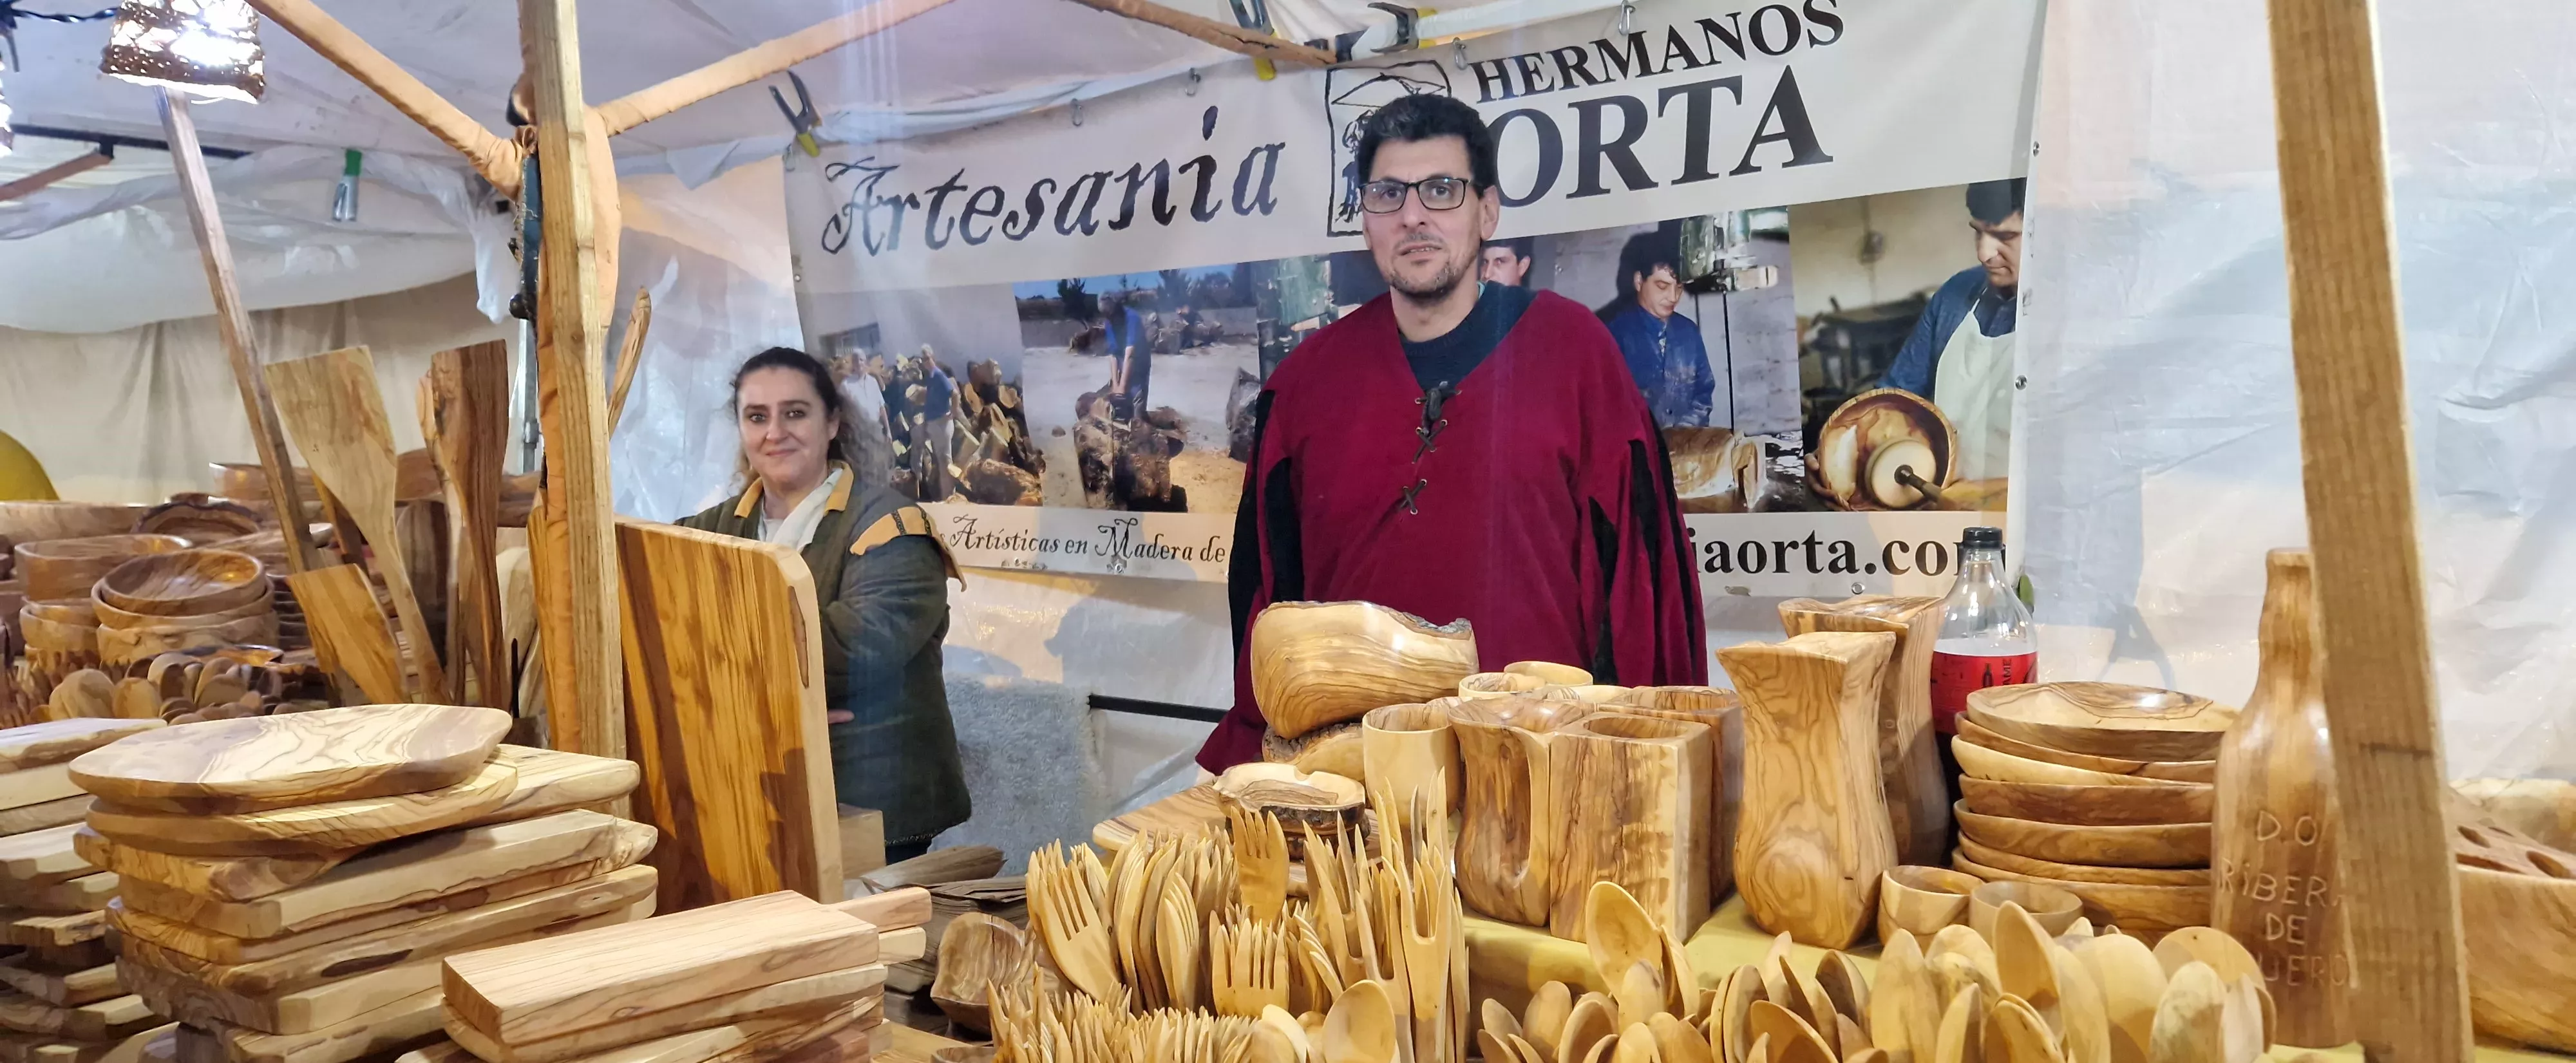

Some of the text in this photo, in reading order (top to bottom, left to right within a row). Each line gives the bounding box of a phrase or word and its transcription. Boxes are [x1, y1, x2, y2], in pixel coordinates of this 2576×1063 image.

[1468, 0, 1844, 104] HERMANOS
[1486, 64, 1833, 208] ORTA
[821, 105, 1286, 256] Artesania
[950, 514, 1061, 553] Artísticas
[1065, 538, 1088, 554] en
[1095, 518, 1193, 560] Madera
[1200, 536, 1226, 563] de
[2265, 912, 2308, 945] DE
[2257, 952, 2350, 986] UERO
